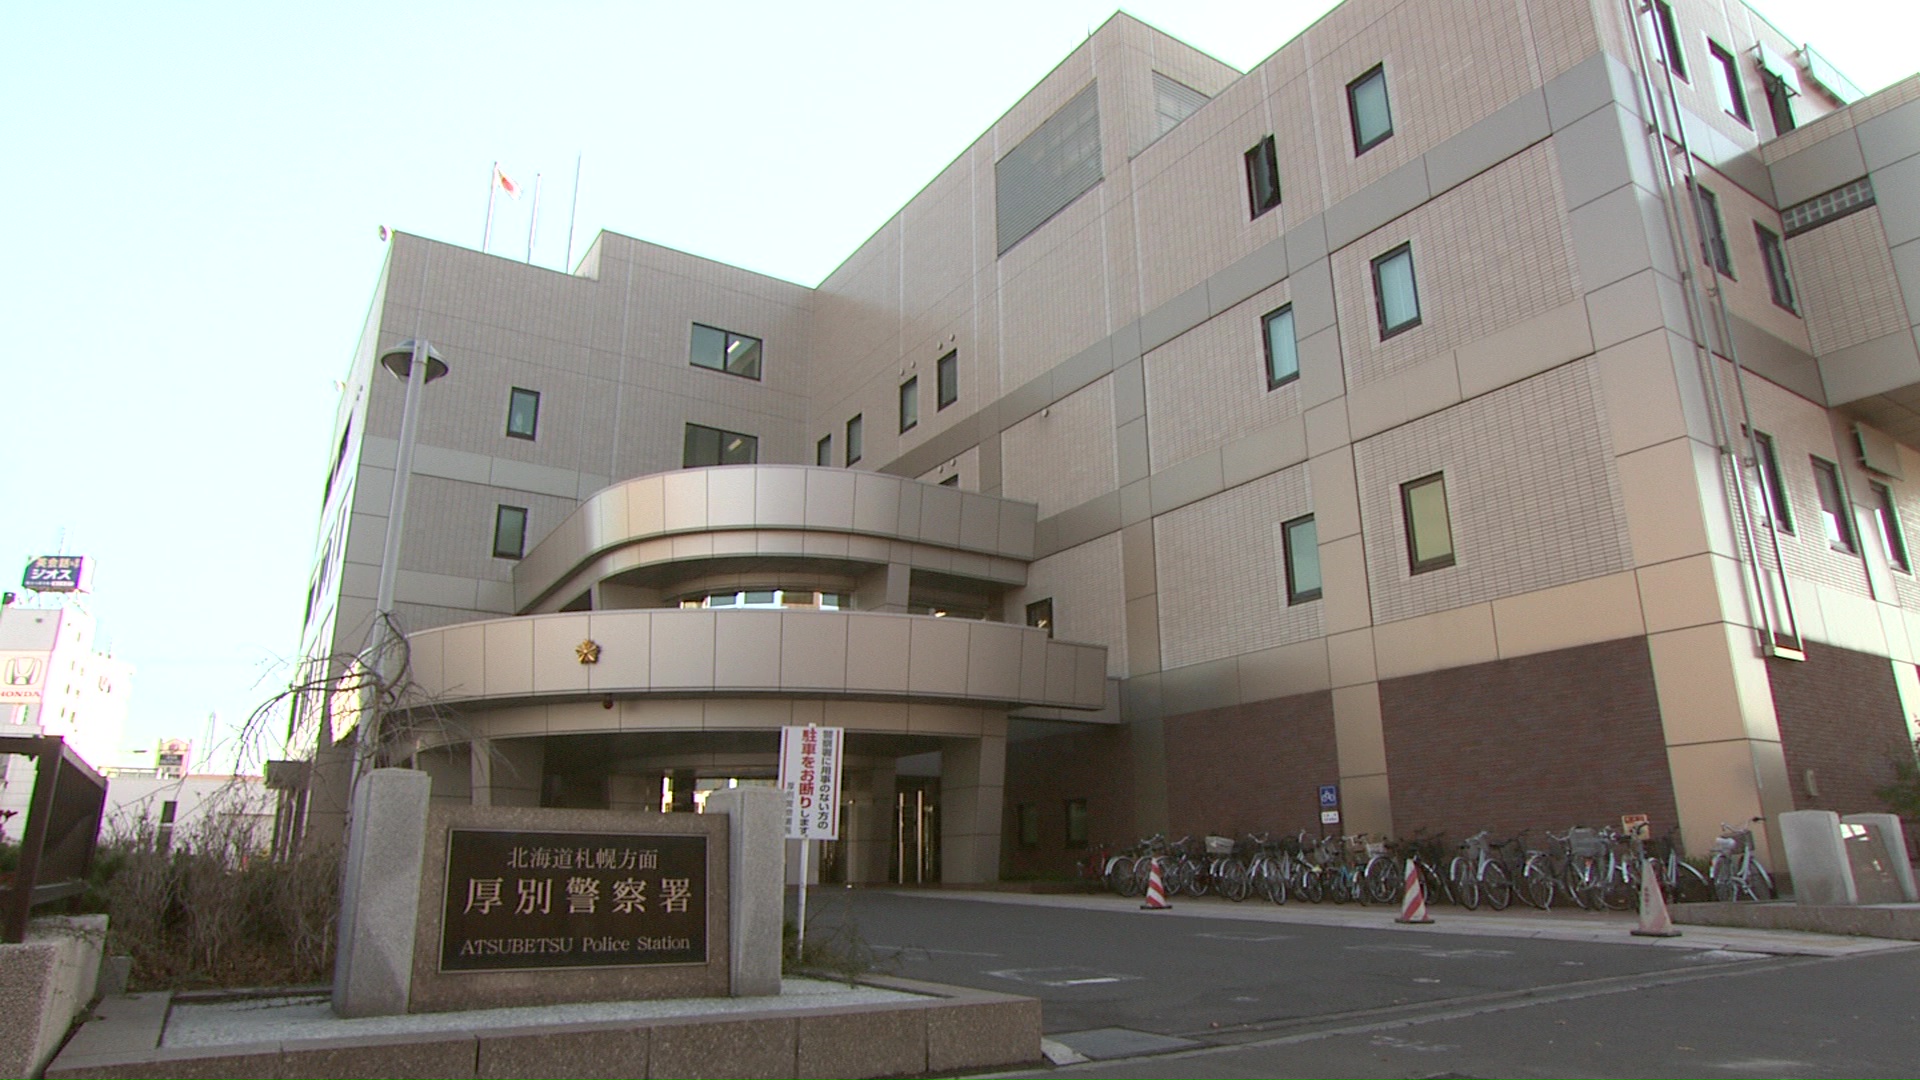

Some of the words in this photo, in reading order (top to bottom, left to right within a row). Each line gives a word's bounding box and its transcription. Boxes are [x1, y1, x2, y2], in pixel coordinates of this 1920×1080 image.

[29, 569, 73, 580] ジオス
[817, 730, 834, 830] 警察署に用事のない方の
[507, 847, 658, 870] 北海道札幌方面
[464, 876, 692, 914] 厚別警察署
[460, 938, 573, 955] ATSUBETSU
[583, 936, 630, 952] Police
[638, 935, 690, 951] Station
